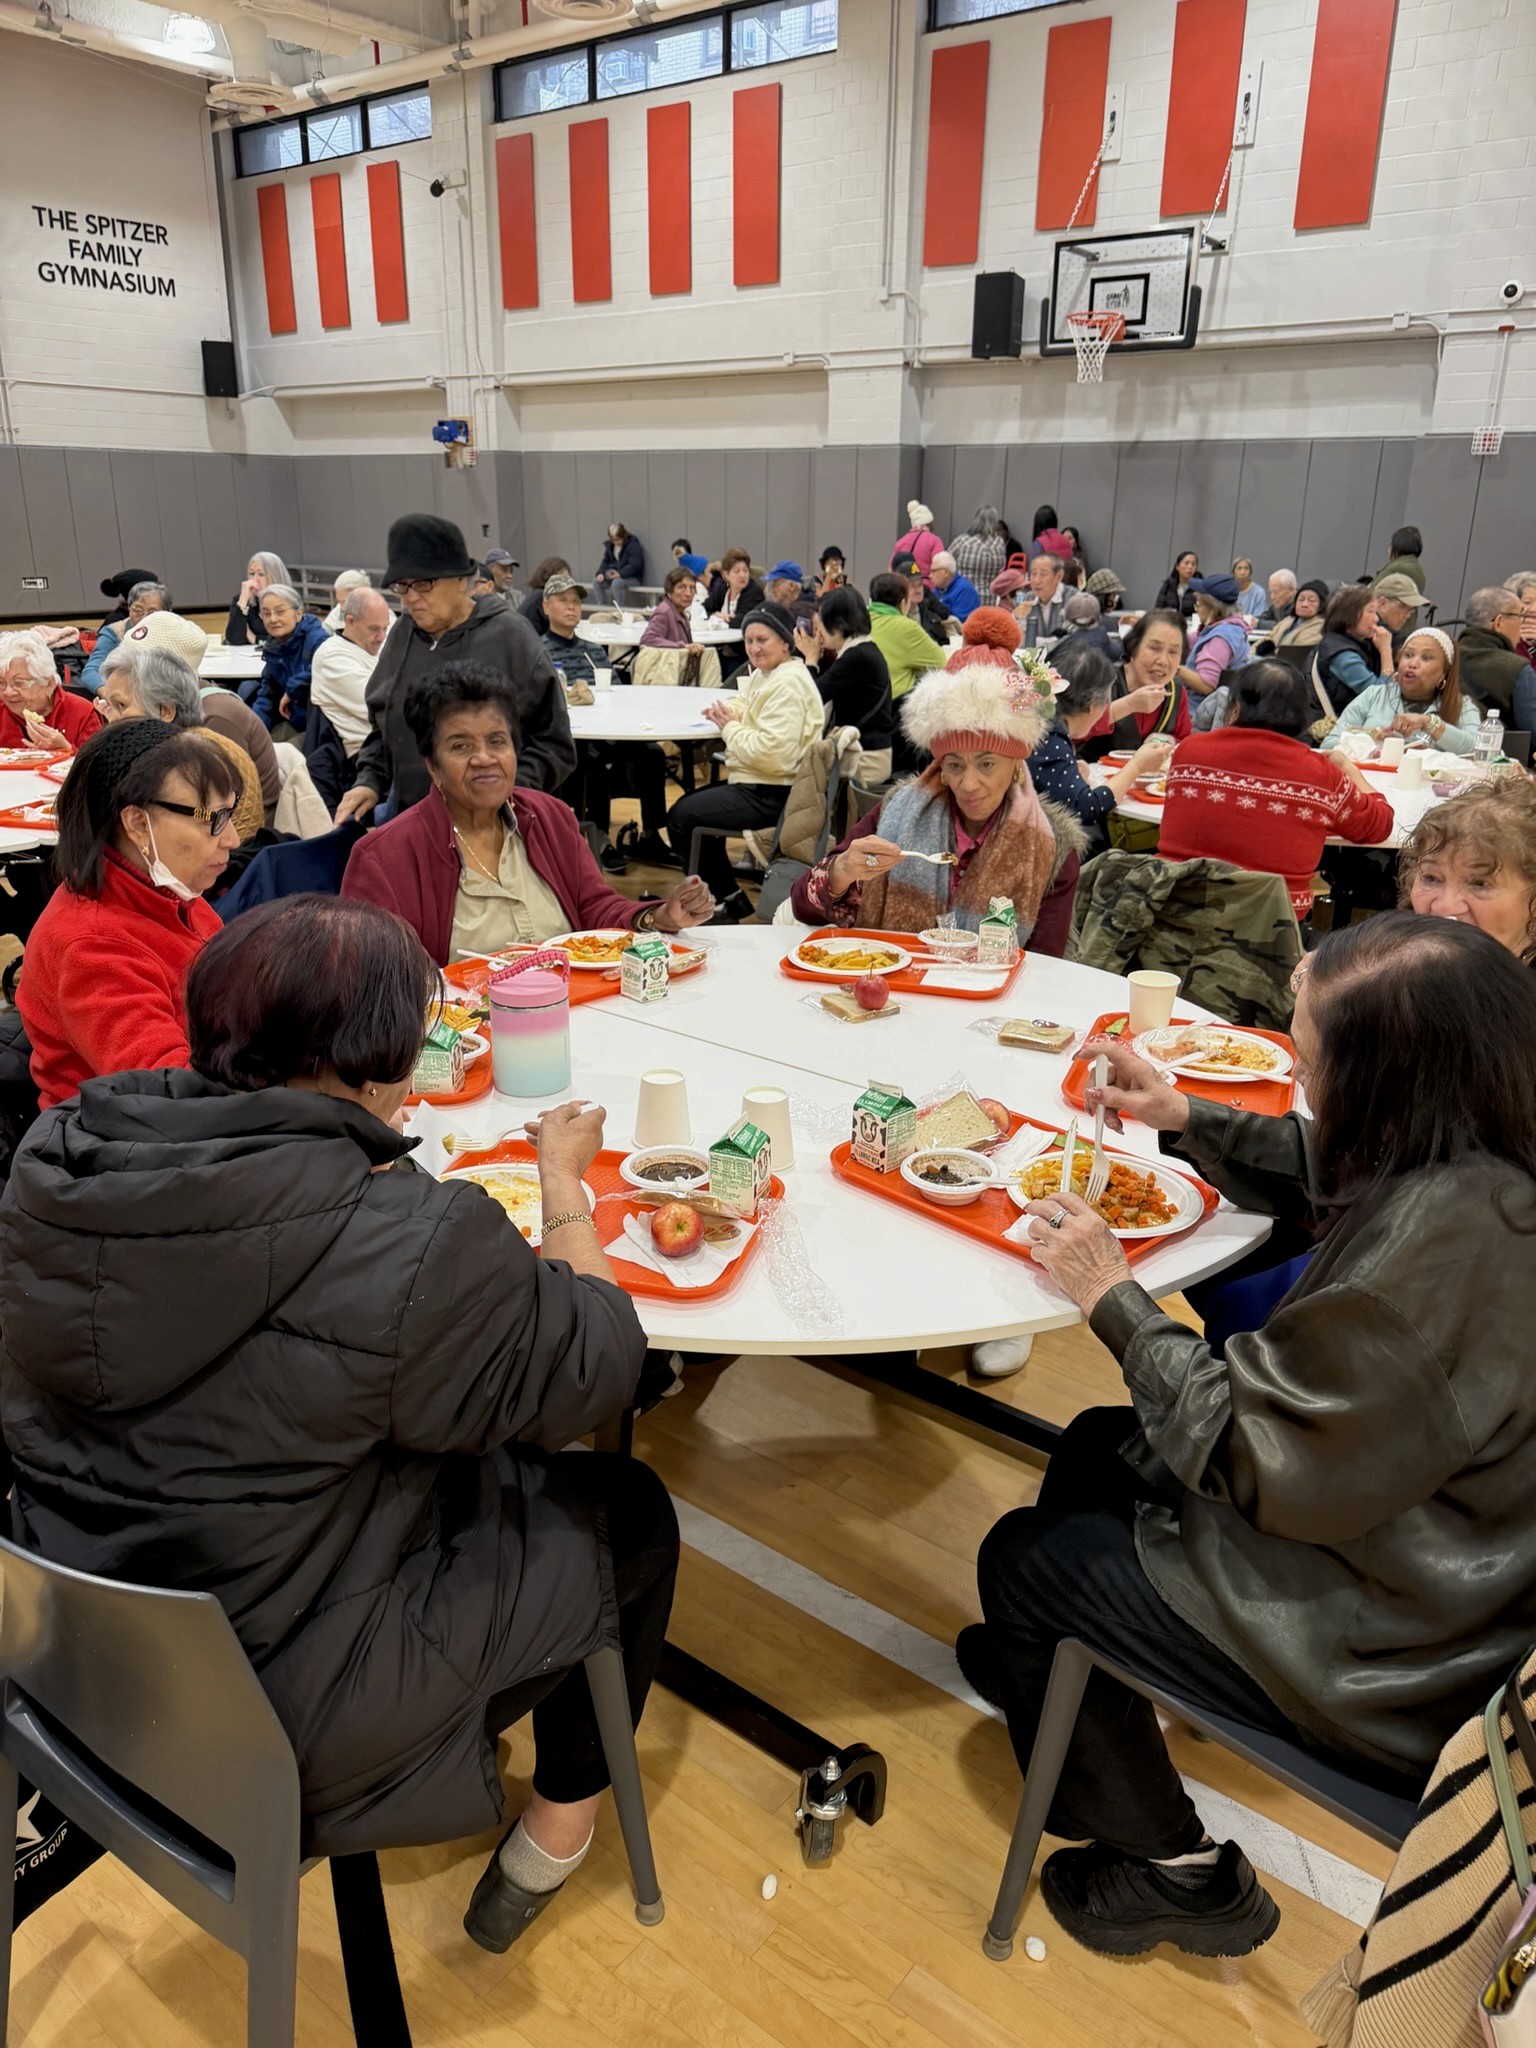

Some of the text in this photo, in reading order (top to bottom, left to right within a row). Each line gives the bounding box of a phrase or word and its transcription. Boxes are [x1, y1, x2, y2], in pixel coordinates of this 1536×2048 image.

[32, 205, 169, 245] THE SPITZER
[68, 239, 143, 267] FAMILY
[38, 262, 176, 297] GYMNASIUM
[30, 1828, 68, 1868] GROUP
